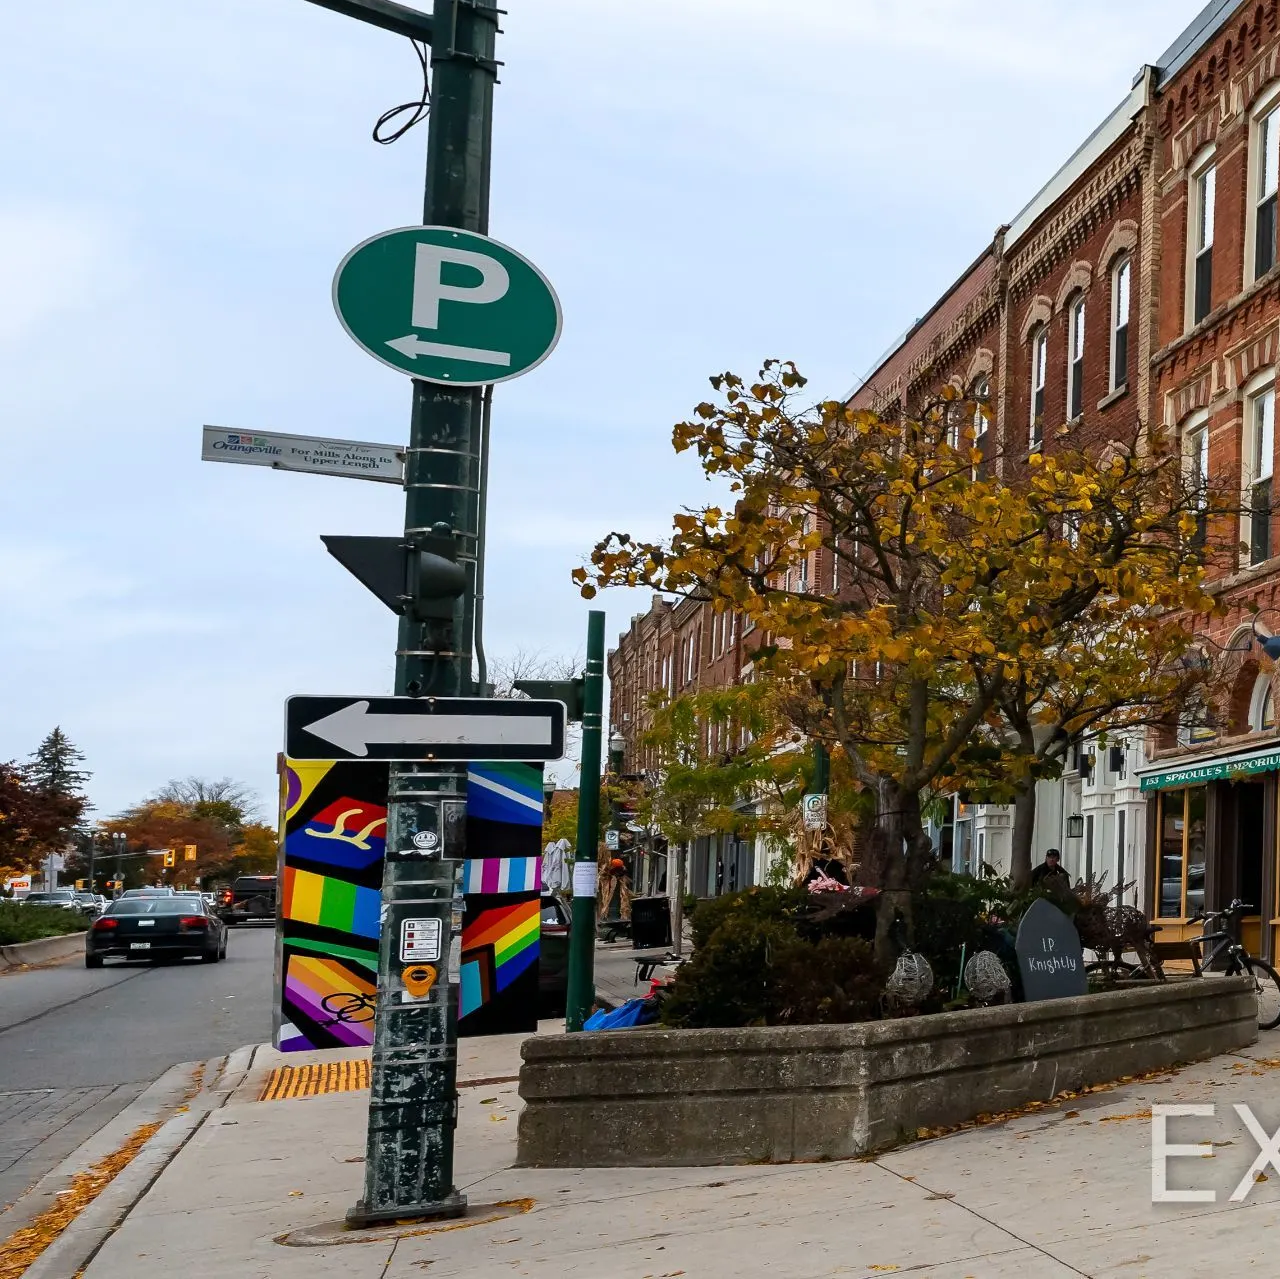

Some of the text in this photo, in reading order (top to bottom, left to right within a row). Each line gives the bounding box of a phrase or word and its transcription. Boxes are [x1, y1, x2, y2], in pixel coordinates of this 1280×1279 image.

[411, 242, 511, 330] P
[212, 440, 282, 455] Orangeville
[304, 456, 380, 469] Upper Length
[313, 449, 341, 458] Mills
[343, 452, 376, 463] Along
[379, 456, 392, 464] Its
[1145, 776, 1159, 785] 153
[1164, 765, 1222, 783] SPROULE'S
[1028, 955, 1077, 974] Knightly
